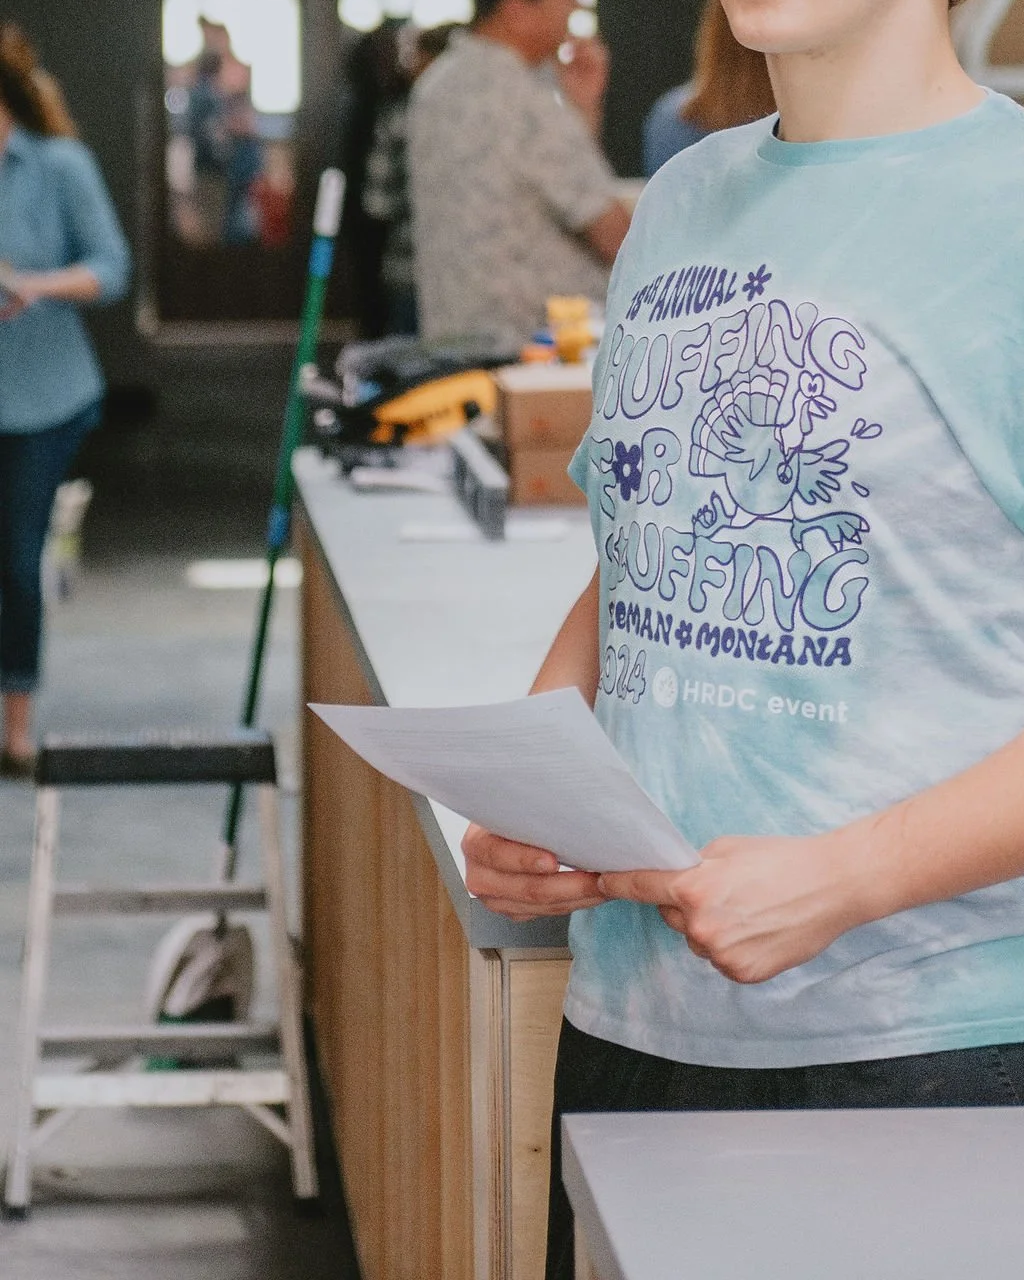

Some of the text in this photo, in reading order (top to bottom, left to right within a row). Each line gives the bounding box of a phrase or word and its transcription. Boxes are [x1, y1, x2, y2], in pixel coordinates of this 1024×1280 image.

[649, 264, 737, 322] ANNUAL
[597, 299, 867, 420] HUFFING
[598, 645, 647, 705] 024
[683, 679, 848, 722] HRDC event
